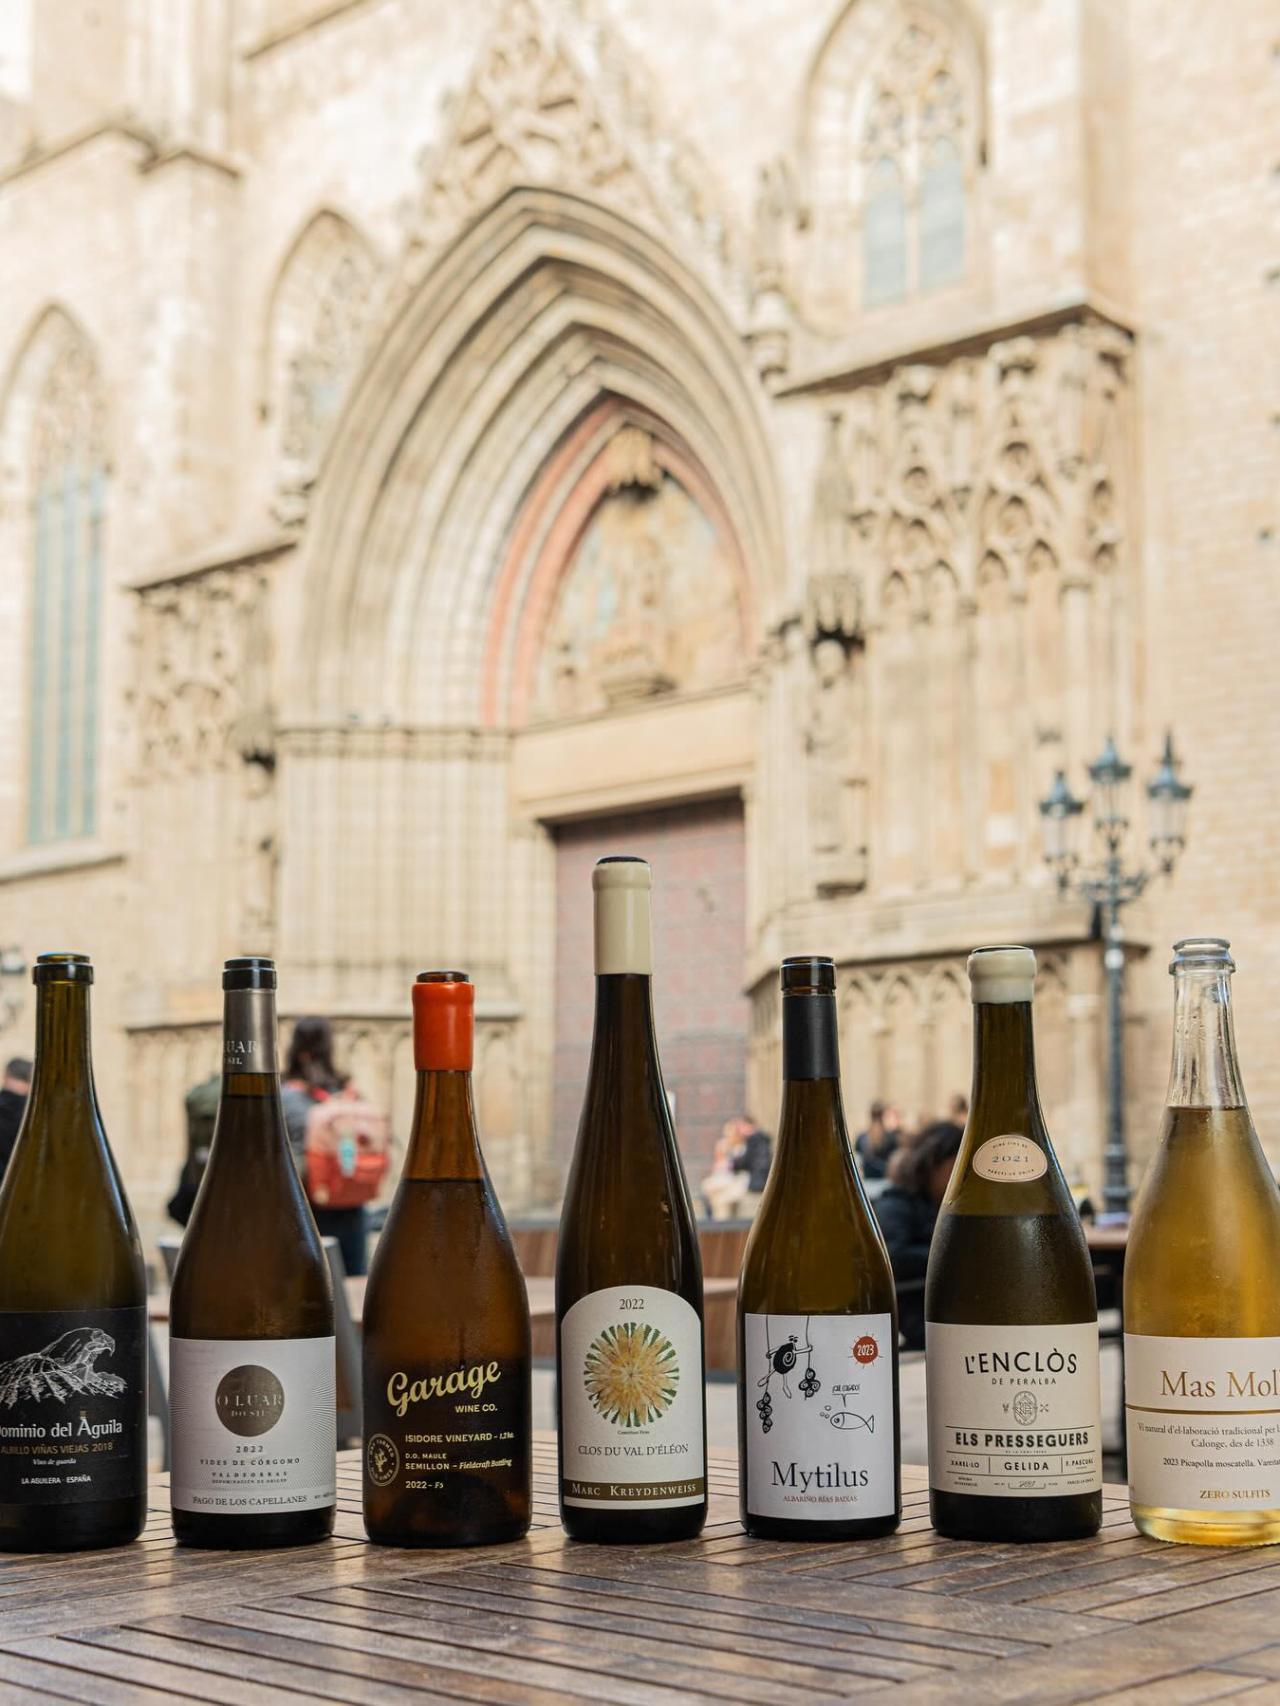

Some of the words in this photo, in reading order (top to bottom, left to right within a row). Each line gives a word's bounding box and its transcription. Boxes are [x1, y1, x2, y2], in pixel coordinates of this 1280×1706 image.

[992, 1155, 1029, 1163] 2021
[619, 1298, 645, 1310] 2022
[857, 1344, 875, 1356] 2023
[965, 1348, 1078, 1374] L'ENCLÒS
[1010, 1377, 1057, 1385] PERALBA
[1160, 1370, 1216, 1397] Mas
[1227, 1369, 1280, 1397] Mol
[387, 1361, 501, 1417] Garage
[455, 1404, 480, 1413] WINE
[482, 1403, 498, 1412] CO.
[0, 1424, 46, 1438] ominio
[51, 1422, 72, 1437] del
[1222, 1426, 1263, 1435] tradicional
[1265, 1427, 1276, 1437] per
[405, 1435, 442, 1443] ISIDORE
[446, 1433, 492, 1443] VINEYARD
[955, 1432, 978, 1446] ELS
[985, 1431, 1089, 1448] PRESSEGUERS
[1230, 1438, 1243, 1447] des
[1245, 1438, 1254, 1447] de
[31, 1443, 58, 1455] VIÑAS
[60, 1444, 89, 1454] VIEJAS
[91, 1442, 113, 1452] 2018
[578, 1445, 602, 1455] CLOS
[604, 1446, 620, 1456] DU
[623, 1446, 644, 1456] VAL
[646, 1444, 689, 1456] D'ÉLÉON
[251, 1457, 300, 1466] CÓRGOMO
[405, 1462, 450, 1470] SEMILLON
[459, 1460, 491, 1470] Fieldcraft
[1004, 1461, 1049, 1471] GELIDA
[1163, 1458, 1179, 1466] 2023
[66, 1474, 91, 1483] ESPAÑA
[771, 1461, 869, 1493] Mytilus
[405, 1480, 427, 1489] 2022
[1200, 1490, 1229, 1499] ZERO
[1231, 1489, 1271, 1499] SULFITS
[192, 1496, 214, 1505] PAGO
[215, 1498, 227, 1506] DE
[229, 1498, 247, 1506] LOS
[249, 1495, 309, 1506] CAPELLANES
